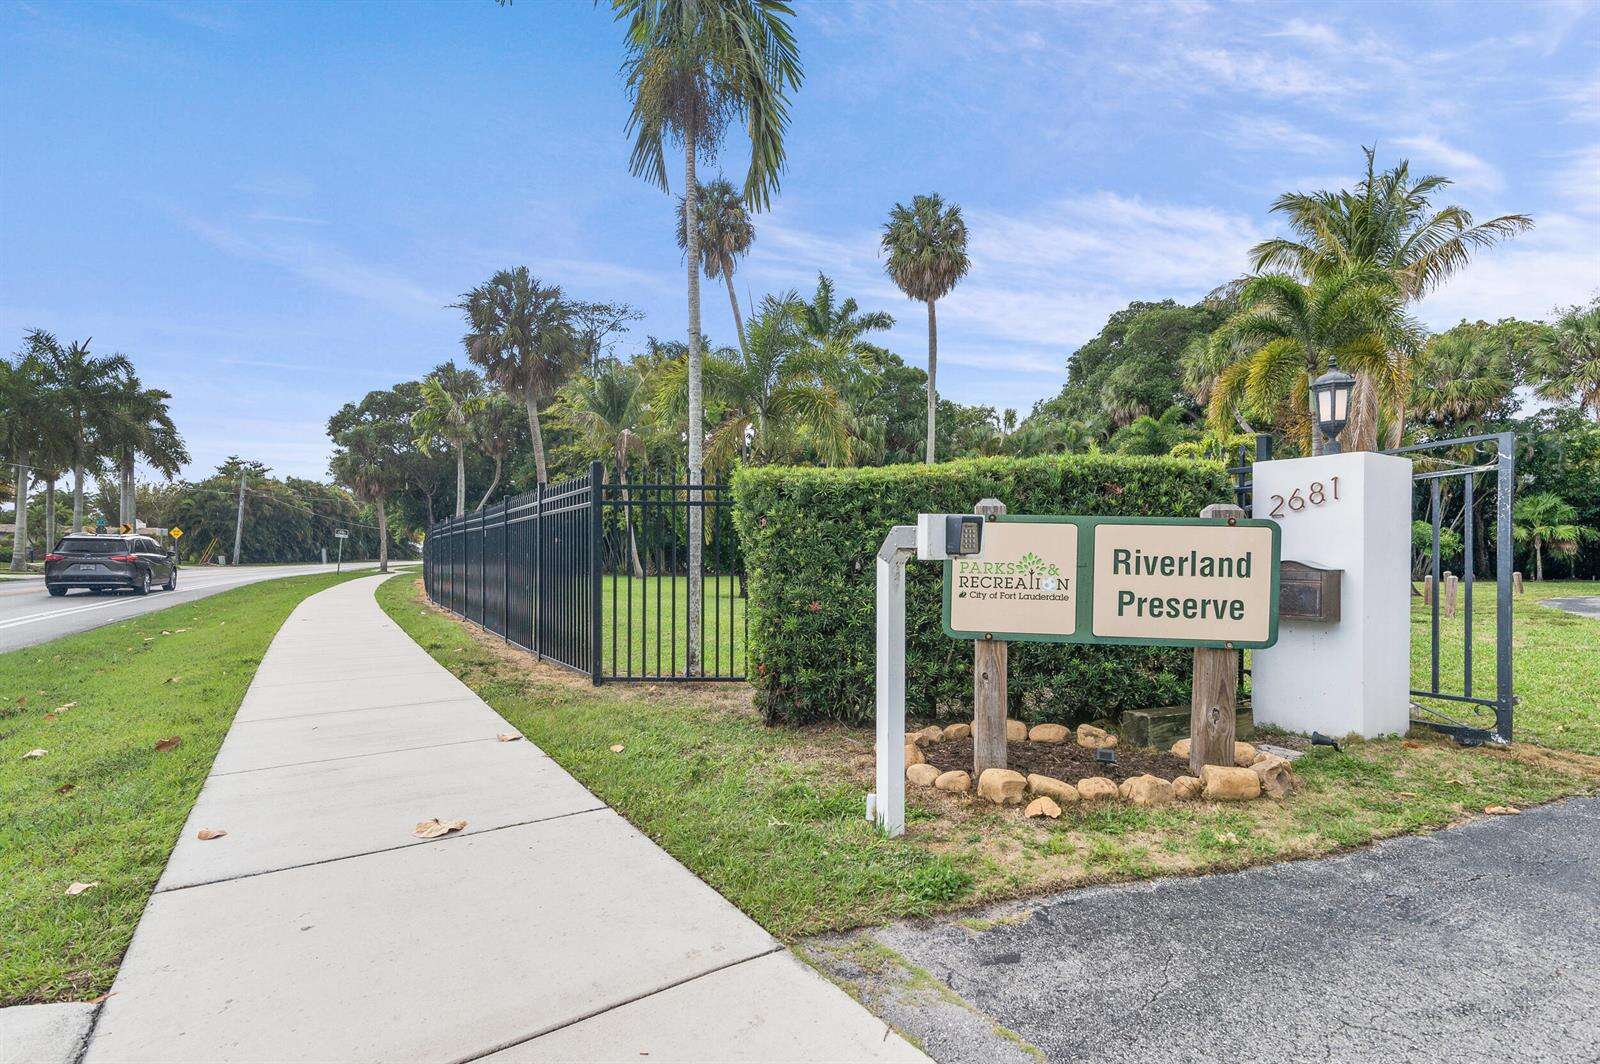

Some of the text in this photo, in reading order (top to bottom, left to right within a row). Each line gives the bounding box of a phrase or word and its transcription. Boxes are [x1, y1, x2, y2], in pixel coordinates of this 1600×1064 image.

[1269, 476, 1339, 518] 2681
[959, 561, 1060, 576] PARKS &
[1113, 549, 1252, 578] Riverland
[969, 591, 1070, 602] City of Fort Lauderdale
[1117, 590, 1245, 621] Preserve
